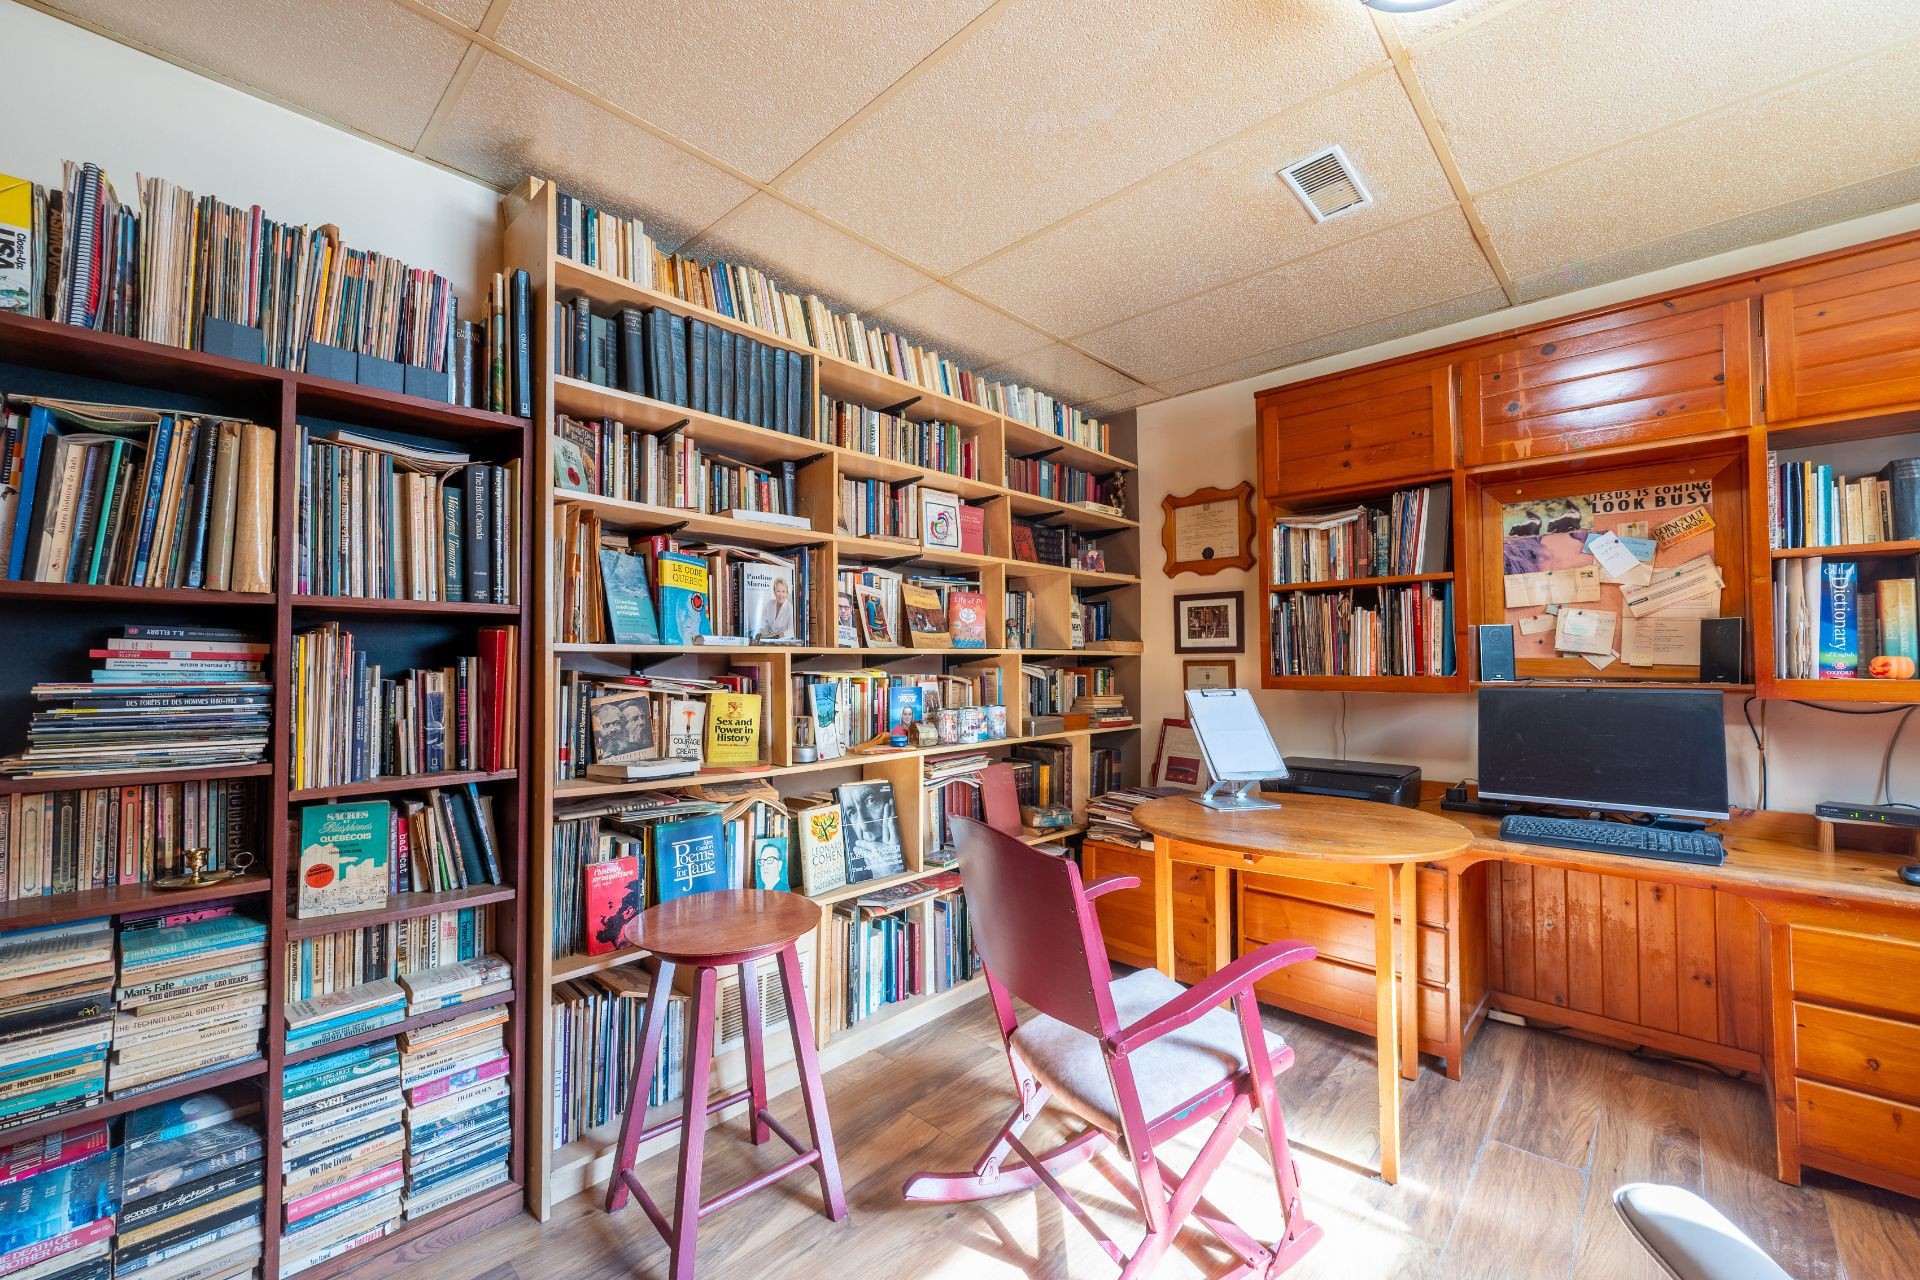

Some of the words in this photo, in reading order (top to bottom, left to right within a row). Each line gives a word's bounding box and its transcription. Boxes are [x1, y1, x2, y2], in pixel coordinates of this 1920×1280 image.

[207, 426, 218, 447] chats
[206, 448, 216, 461] des
[68, 455, 78, 473] chats
[65, 474, 74, 483] de
[475, 470, 484, 486] The
[61, 483, 73, 512] histoires
[475, 485, 485, 504] Birds
[1592, 490, 1631, 501] JESUS
[1637, 488, 1648, 497] IS
[1655, 481, 1711, 495] COMING
[475, 504, 485, 514] of
[1591, 497, 1645, 514] LOOK
[1655, 490, 1711, 508] BUSY
[58, 512, 69, 535] Autres
[446, 495, 459, 537] Waterfowl
[1654, 517, 1683, 537] GOING
[1684, 508, 1705, 524] OUT
[475, 513, 485, 540] Canada
[1668, 528, 1683, 539] OUR
[447, 538, 460, 580] Tomorrow
[672, 564, 683, 573] LE
[684, 566, 703, 577] CODE
[746, 573, 773, 582] Pauline
[747, 580, 771, 588] Marois
[1828, 577, 1851, 651] Dictionary
[714, 726, 743, 735] Power
[744, 726, 754, 734] in
[716, 717, 733, 726] Sex
[734, 718, 753, 727] and
[673, 737, 701, 746] COURAGE
[716, 734, 751, 743] History
[676, 747, 698, 755] CREATE
[326, 810, 369, 821] SACRES
[319, 832, 372, 844] QUÉBÉCOIS
[399, 832, 408, 854] bad
[672, 844, 715, 868] Poems
[811, 842, 842, 855] LEONARD
[399, 857, 408, 875] cat
[812, 850, 843, 866] COHEN
[676, 866, 688, 878] for
[682, 860, 716, 892] Jane
[814, 877, 845, 891] NOTEBOOKS
[124, 985, 152, 1000] Man's
[154, 981, 175, 994] Fate
[182, 975, 203, 987] André
[148, 992, 163, 1001] THE
[163, 987, 191, 999] QUEBEC
[191, 983, 209, 993] PLOT
[213, 979, 227, 988] LEO
[228, 975, 249, 986] HEAPS
[115, 1024, 130, 1033] THE
[133, 1010, 194, 1029] TECHNOLOGICAL
[195, 1003, 225, 1015] SOCIETY
[200, 1028, 230, 1039] MARGARET
[231, 1023, 248, 1032] MEAD
[16, 1074, 52, 1088] Hermann
[53, 1068, 76, 1080] Hesse
[405, 1071, 432, 1084] Michael
[433, 1062, 456, 1074] Dibdin
[474, 1086, 492, 1096] OLSEN
[345, 1095, 388, 1113] EXPERIMENT
[309, 1166, 320, 1176] We
[320, 1162, 332, 1173] The
[332, 1153, 353, 1170] Living
[13, 1239, 53, 1261] DEATH
[55, 1233, 73, 1244] OF
[53, 1238, 83, 1254] ABEL
